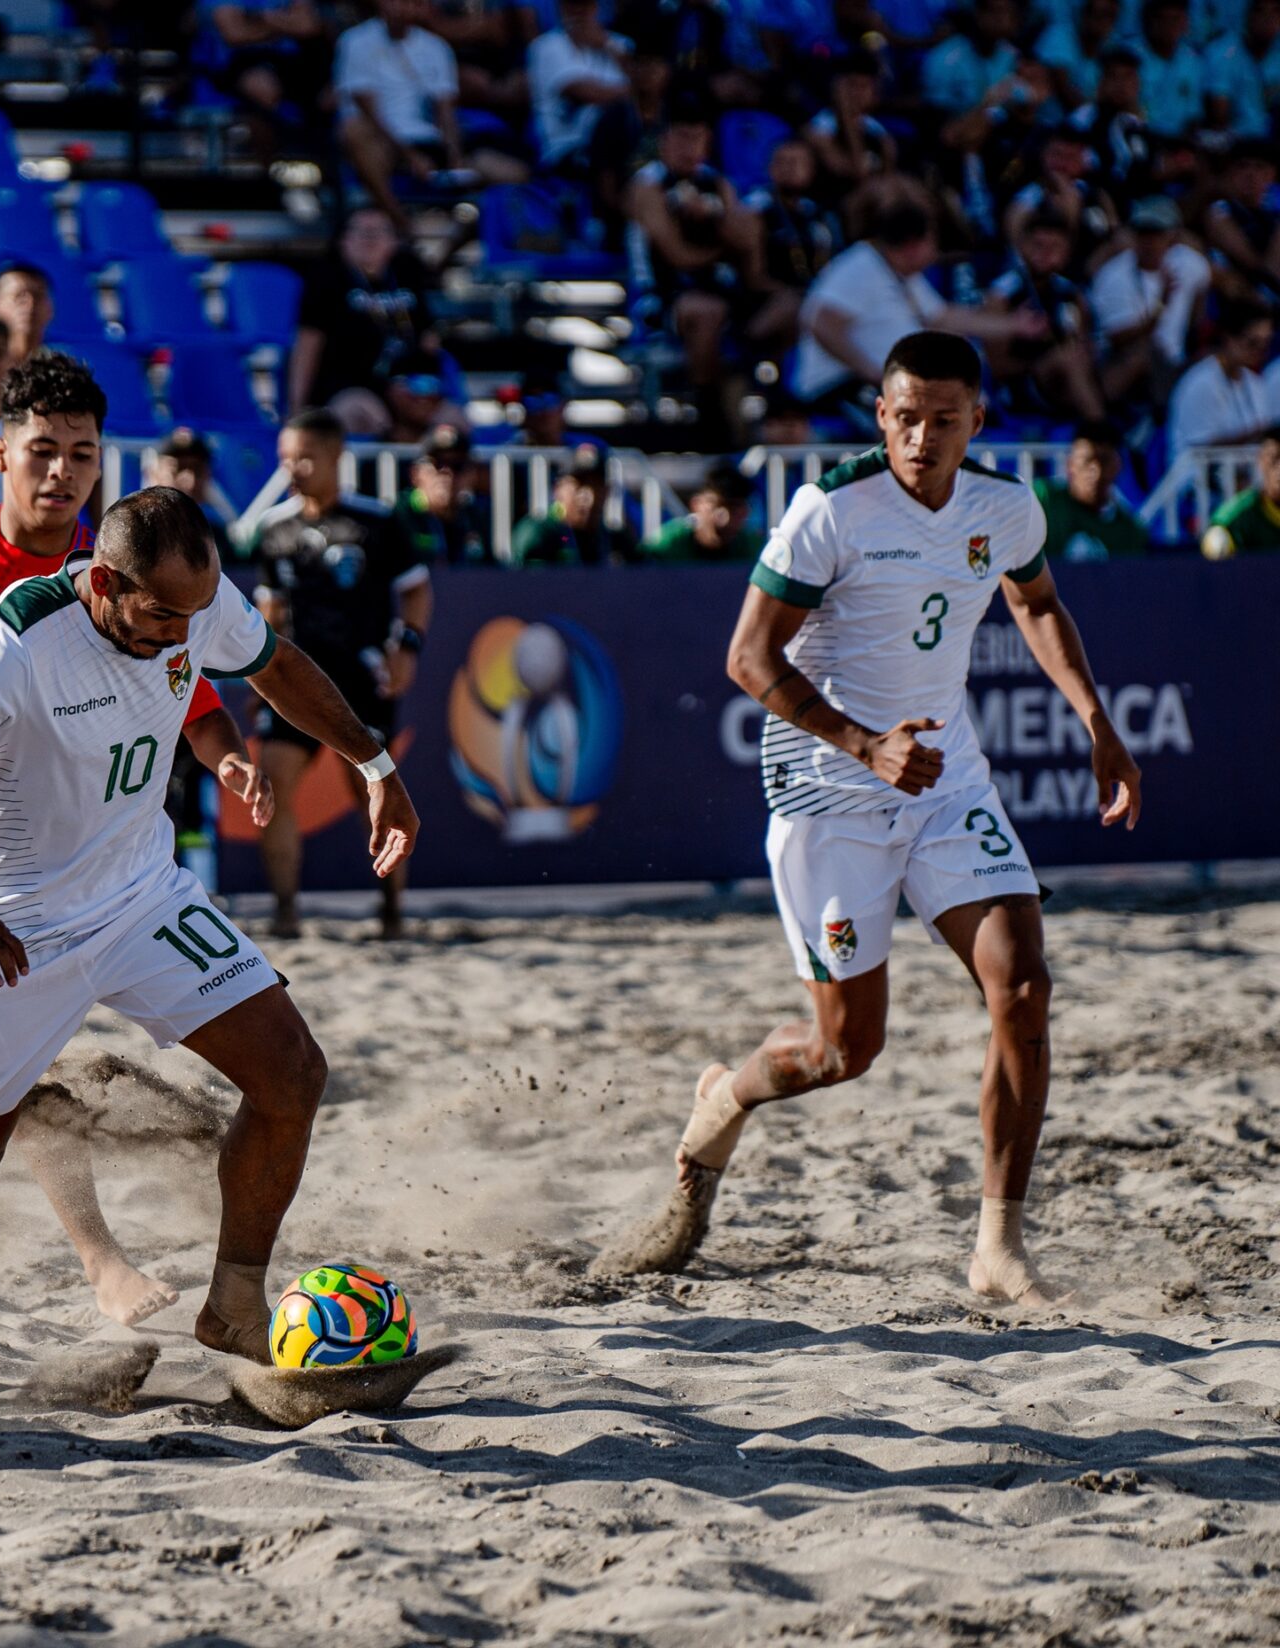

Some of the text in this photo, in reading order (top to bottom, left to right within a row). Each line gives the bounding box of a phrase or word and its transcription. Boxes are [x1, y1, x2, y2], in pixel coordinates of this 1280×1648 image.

[864, 548, 922, 560] marathon
[913, 593, 949, 650] 3
[53, 695, 117, 717] marathon
[104, 735, 158, 803] 10
[965, 807, 1013, 857] 3
[973, 862, 1031, 877] maratho
[152, 904, 239, 973] 10
[198, 956, 262, 997] marathon
